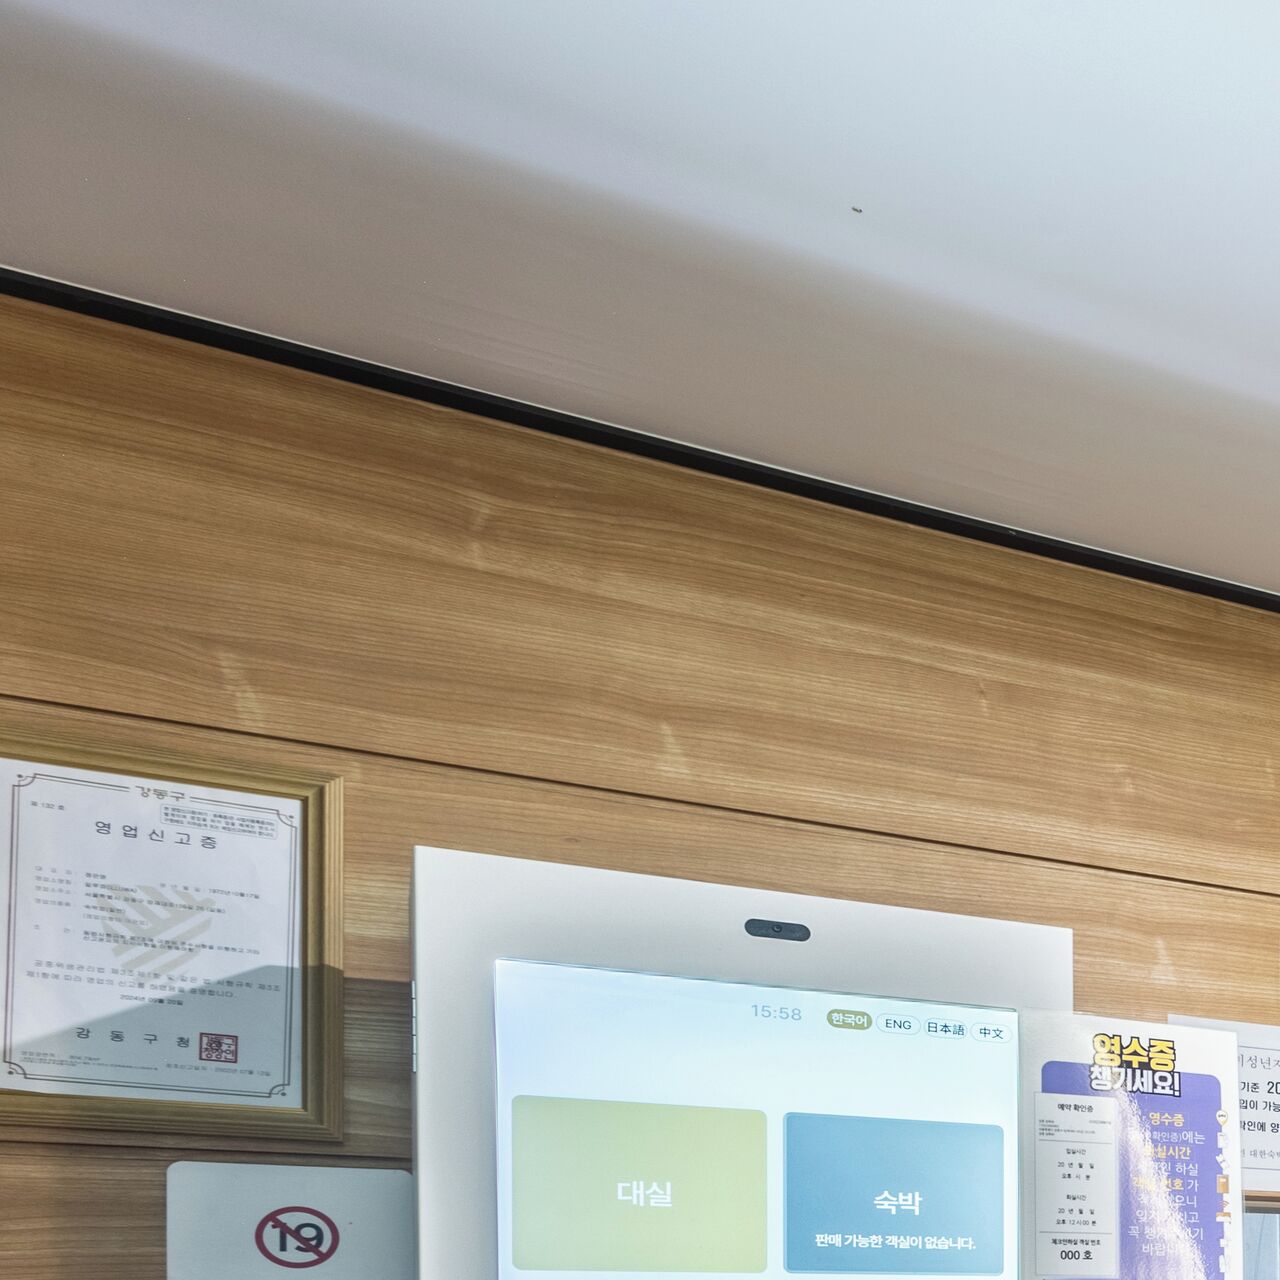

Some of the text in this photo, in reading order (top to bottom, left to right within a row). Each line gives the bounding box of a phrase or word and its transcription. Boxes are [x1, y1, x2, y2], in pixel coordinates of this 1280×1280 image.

[135, 786, 185, 801] 강동구
[751, 1004, 802, 1021] 15:58
[831, 1011, 1004, 1040] 한국어 ENG 日本語 中文
[1092, 1033, 1176, 1072] 영수증
[1089, 1065, 1181, 1097] 챙기세요!
[1240, 1081, 1260, 1094] 기준
[1149, 1112, 1185, 1127] 영수증
[1175, 1162, 1199, 1177] 하실
[617, 1180, 673, 1207] 대실
[1187, 1179, 1200, 1193] 가
[873, 1190, 922, 1215] 숙박
[815, 1233, 976, 1251] 판매 가능한 객실이 없습니다.
[1060, 1250, 1093, 1261] 000 호
